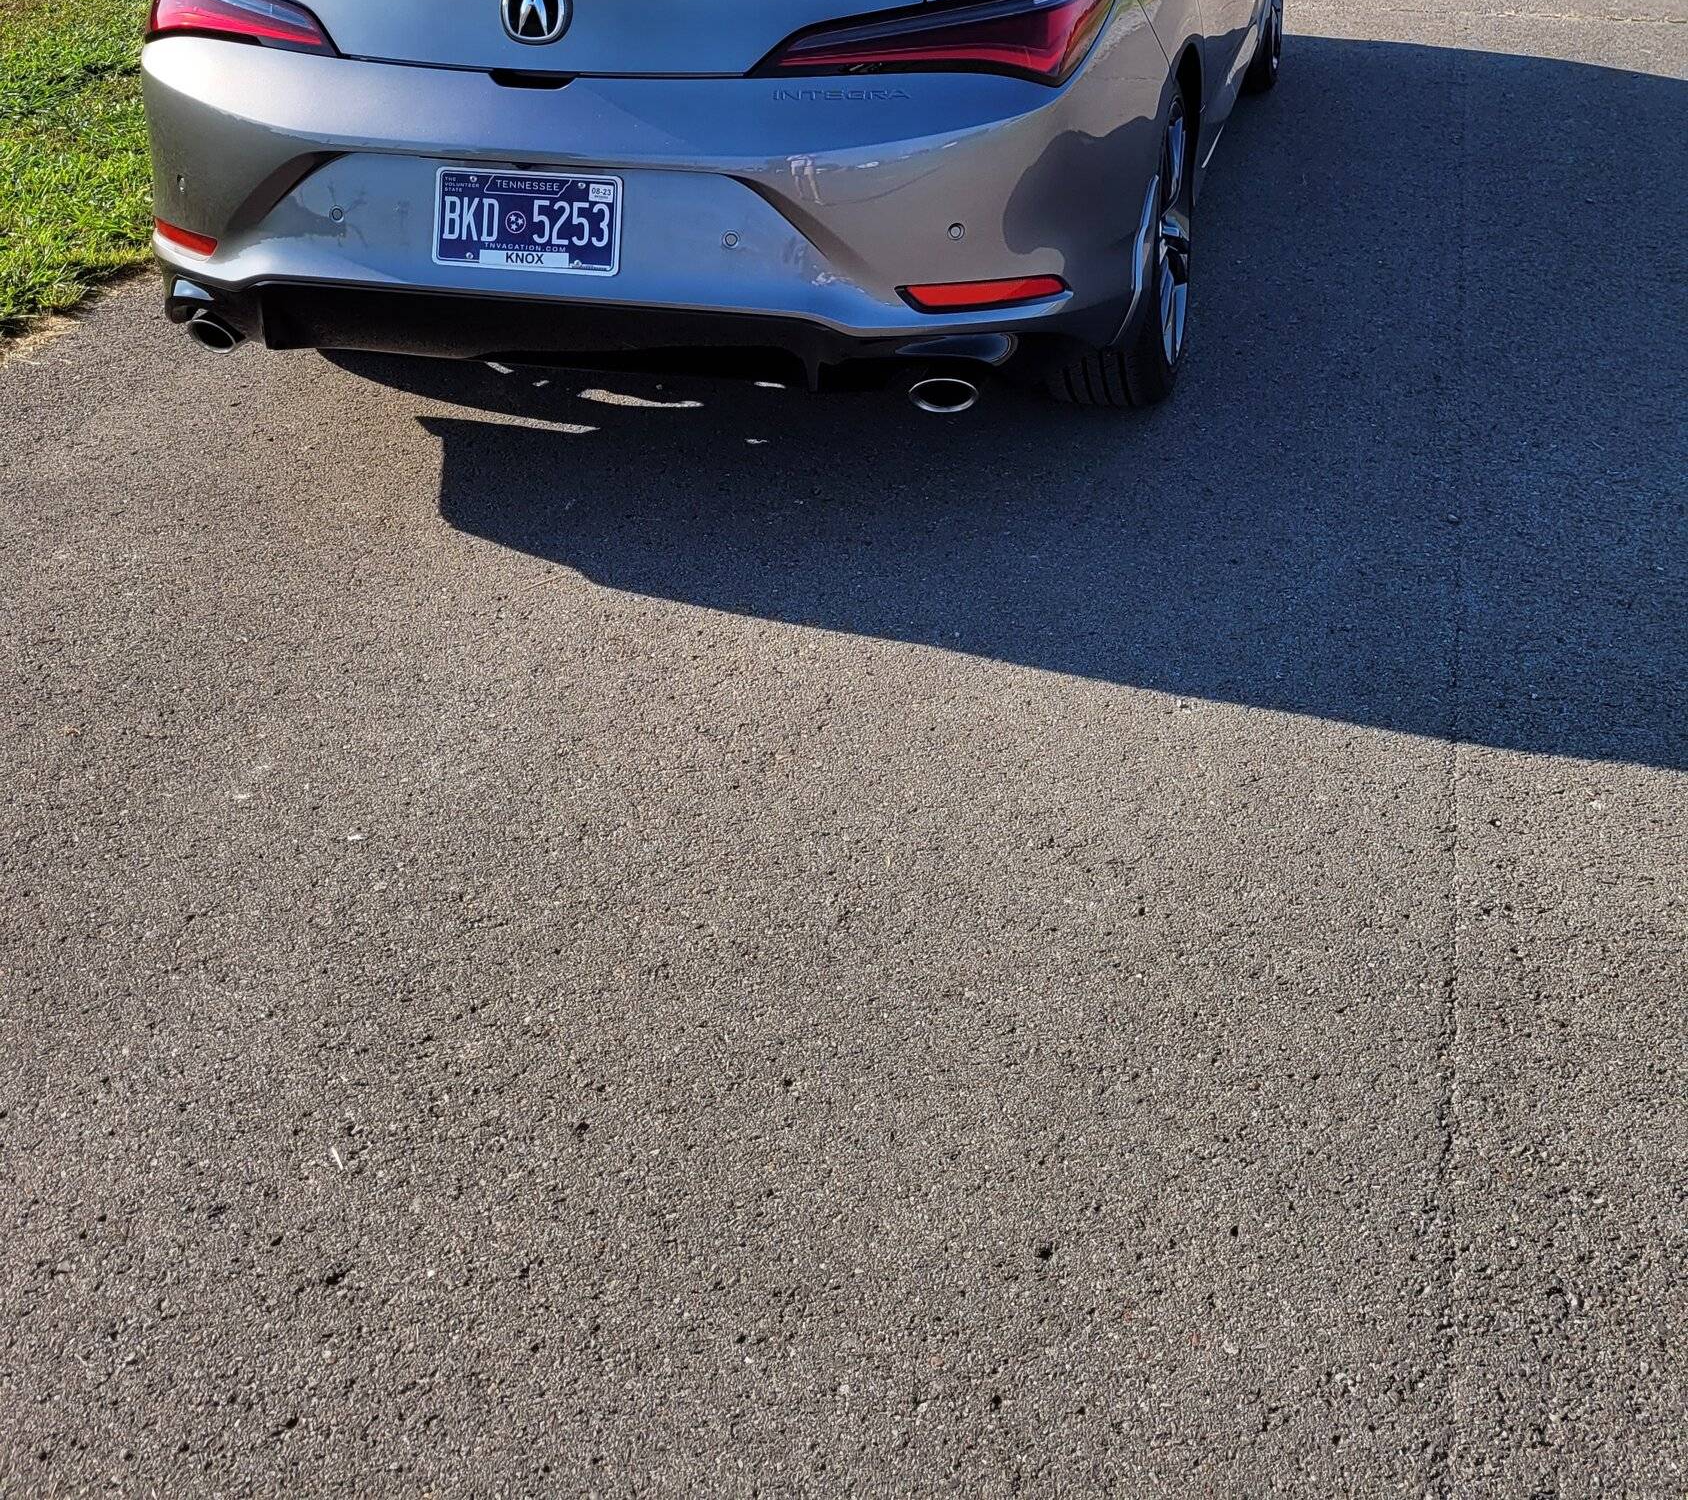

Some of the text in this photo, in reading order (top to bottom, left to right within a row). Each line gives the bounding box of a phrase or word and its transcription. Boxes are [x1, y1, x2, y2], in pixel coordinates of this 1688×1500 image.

[772, 89, 913, 101] INTEGRA
[495, 179, 560, 192] TENNESSEE
[442, 195, 611, 248] BKD 5253
[484, 242, 567, 253] TNVACATION.COM
[505, 252, 544, 265] KNOX
